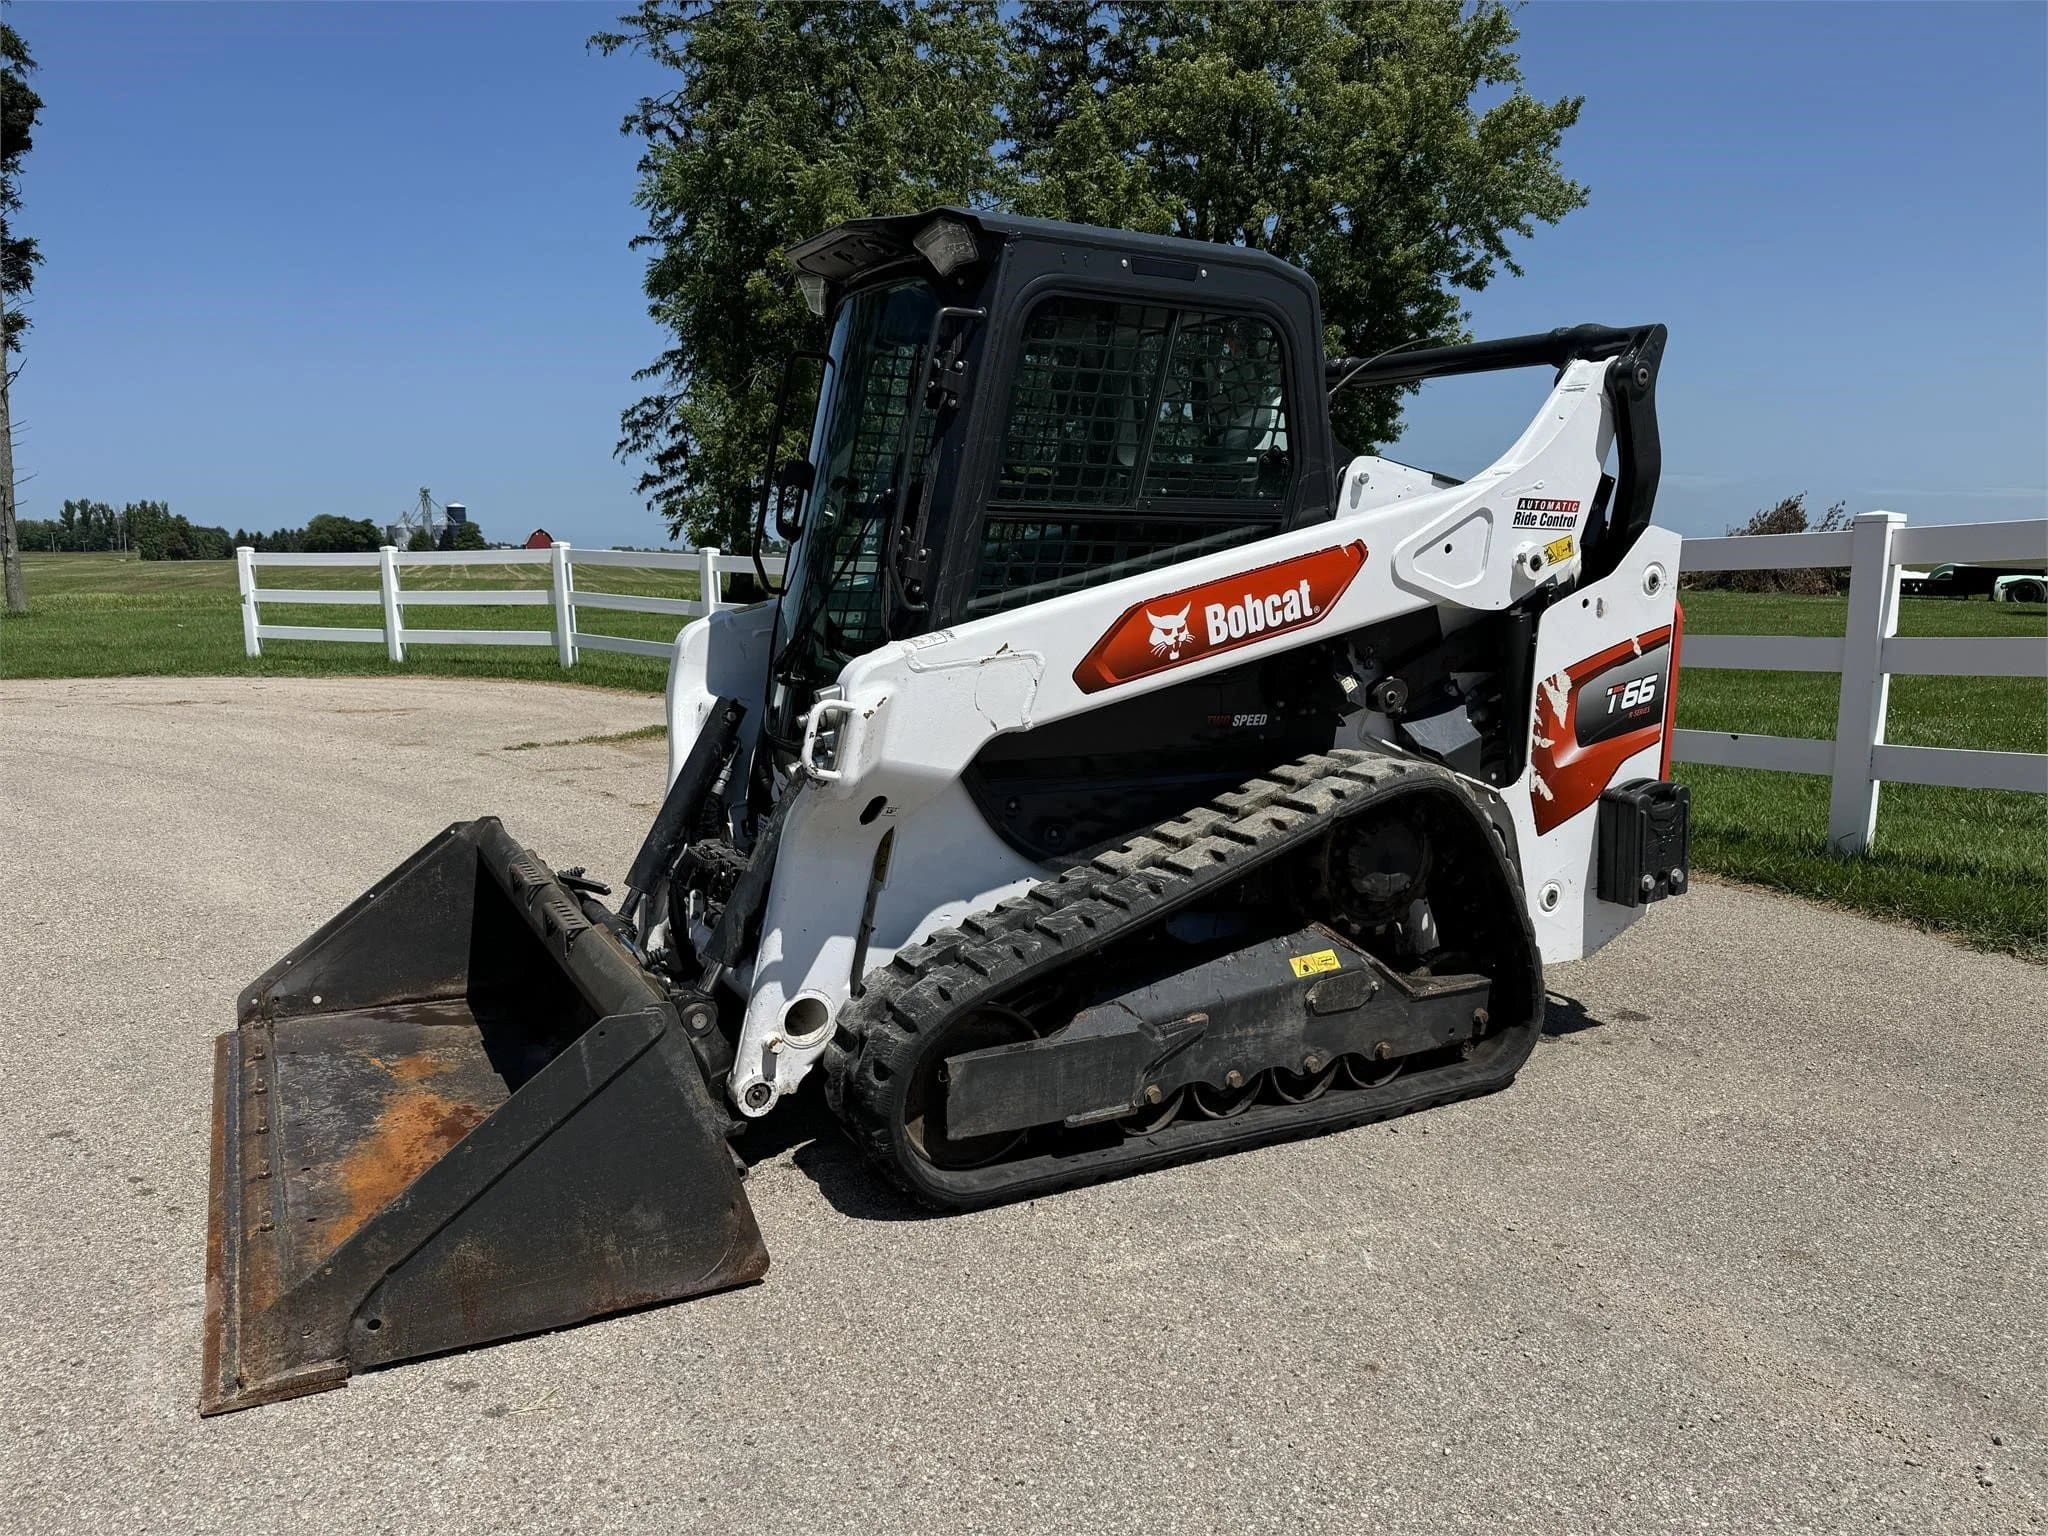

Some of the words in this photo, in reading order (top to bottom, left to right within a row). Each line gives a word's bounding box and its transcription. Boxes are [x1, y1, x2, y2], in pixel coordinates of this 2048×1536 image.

[1519, 500, 1578, 511] AUTOMATIC
[1513, 512, 1537, 526] Ride
[1540, 513, 1577, 528] Control
[1204, 579, 1313, 646] Bobcat
[1606, 674, 1658, 714] T66
[1232, 714, 1268, 727] SPEED
